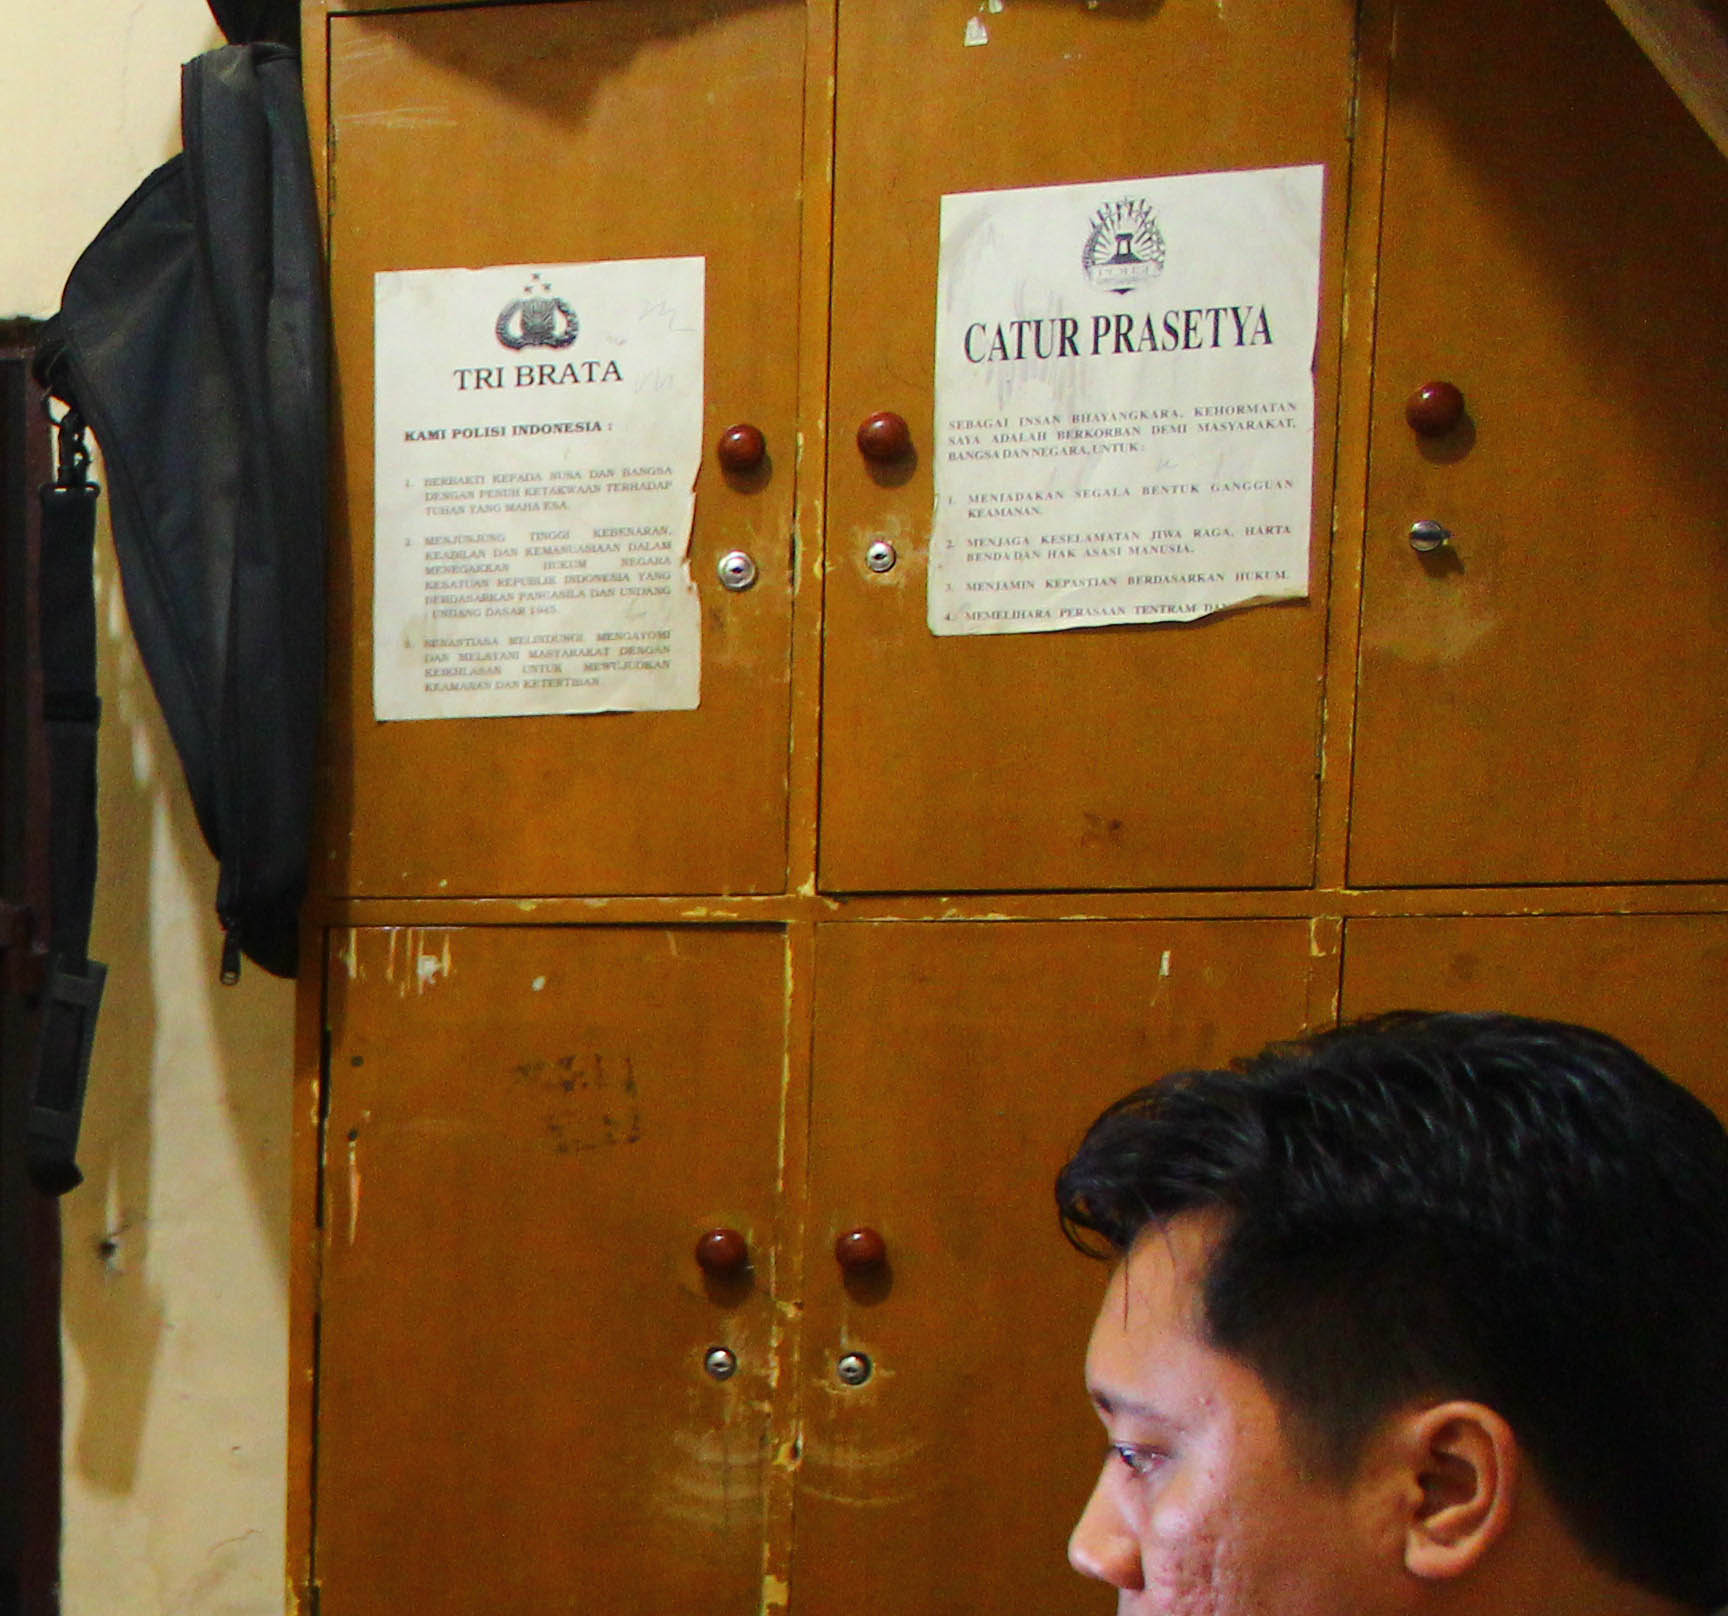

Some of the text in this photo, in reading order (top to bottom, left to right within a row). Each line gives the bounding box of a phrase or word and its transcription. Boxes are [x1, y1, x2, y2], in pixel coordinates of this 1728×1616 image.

[963, 304, 1273, 363] CATUR PRASETYA
[454, 360, 624, 390] TRI BRATA
[948, 419, 1009, 431] SEBAGAI
[1019, 415, 1062, 426] INSAN
[1194, 402, 1296, 416] KEHORMATAN
[404, 429, 446, 442] KAMI
[452, 426, 506, 439] POLISI
[511, 421, 602, 435] INDONESIA
[948, 435, 981, 447] SAYA
[992, 431, 1046, 444] ADALAH
[1057, 426, 1141, 441] BERKORBAN
[1152, 423, 1188, 435] DEMI
[1075, 487, 1130, 499] SEGALA
[1142, 483, 1199, 496] BENTUK
[1210, 479, 1293, 493] GANGGUAN
[967, 535, 1030, 548] MENJAGA
[1041, 531, 1147, 545] KESELAMATAN
[1245, 524, 1290, 536] HARTA
[1048, 547, 1076, 559] HAK
[1083, 546, 1122, 557] ASASI
[966, 579, 1035, 592] MENJAMIN
[1045, 575, 1117, 589] KEPASTIAN
[1128, 571, 1225, 585] BERDASARKAN
[965, 608, 1052, 621] MEMELIHARA
[1060, 604, 1126, 618] PERASAAN
[1135, 602, 1195, 615] TENTRAM
